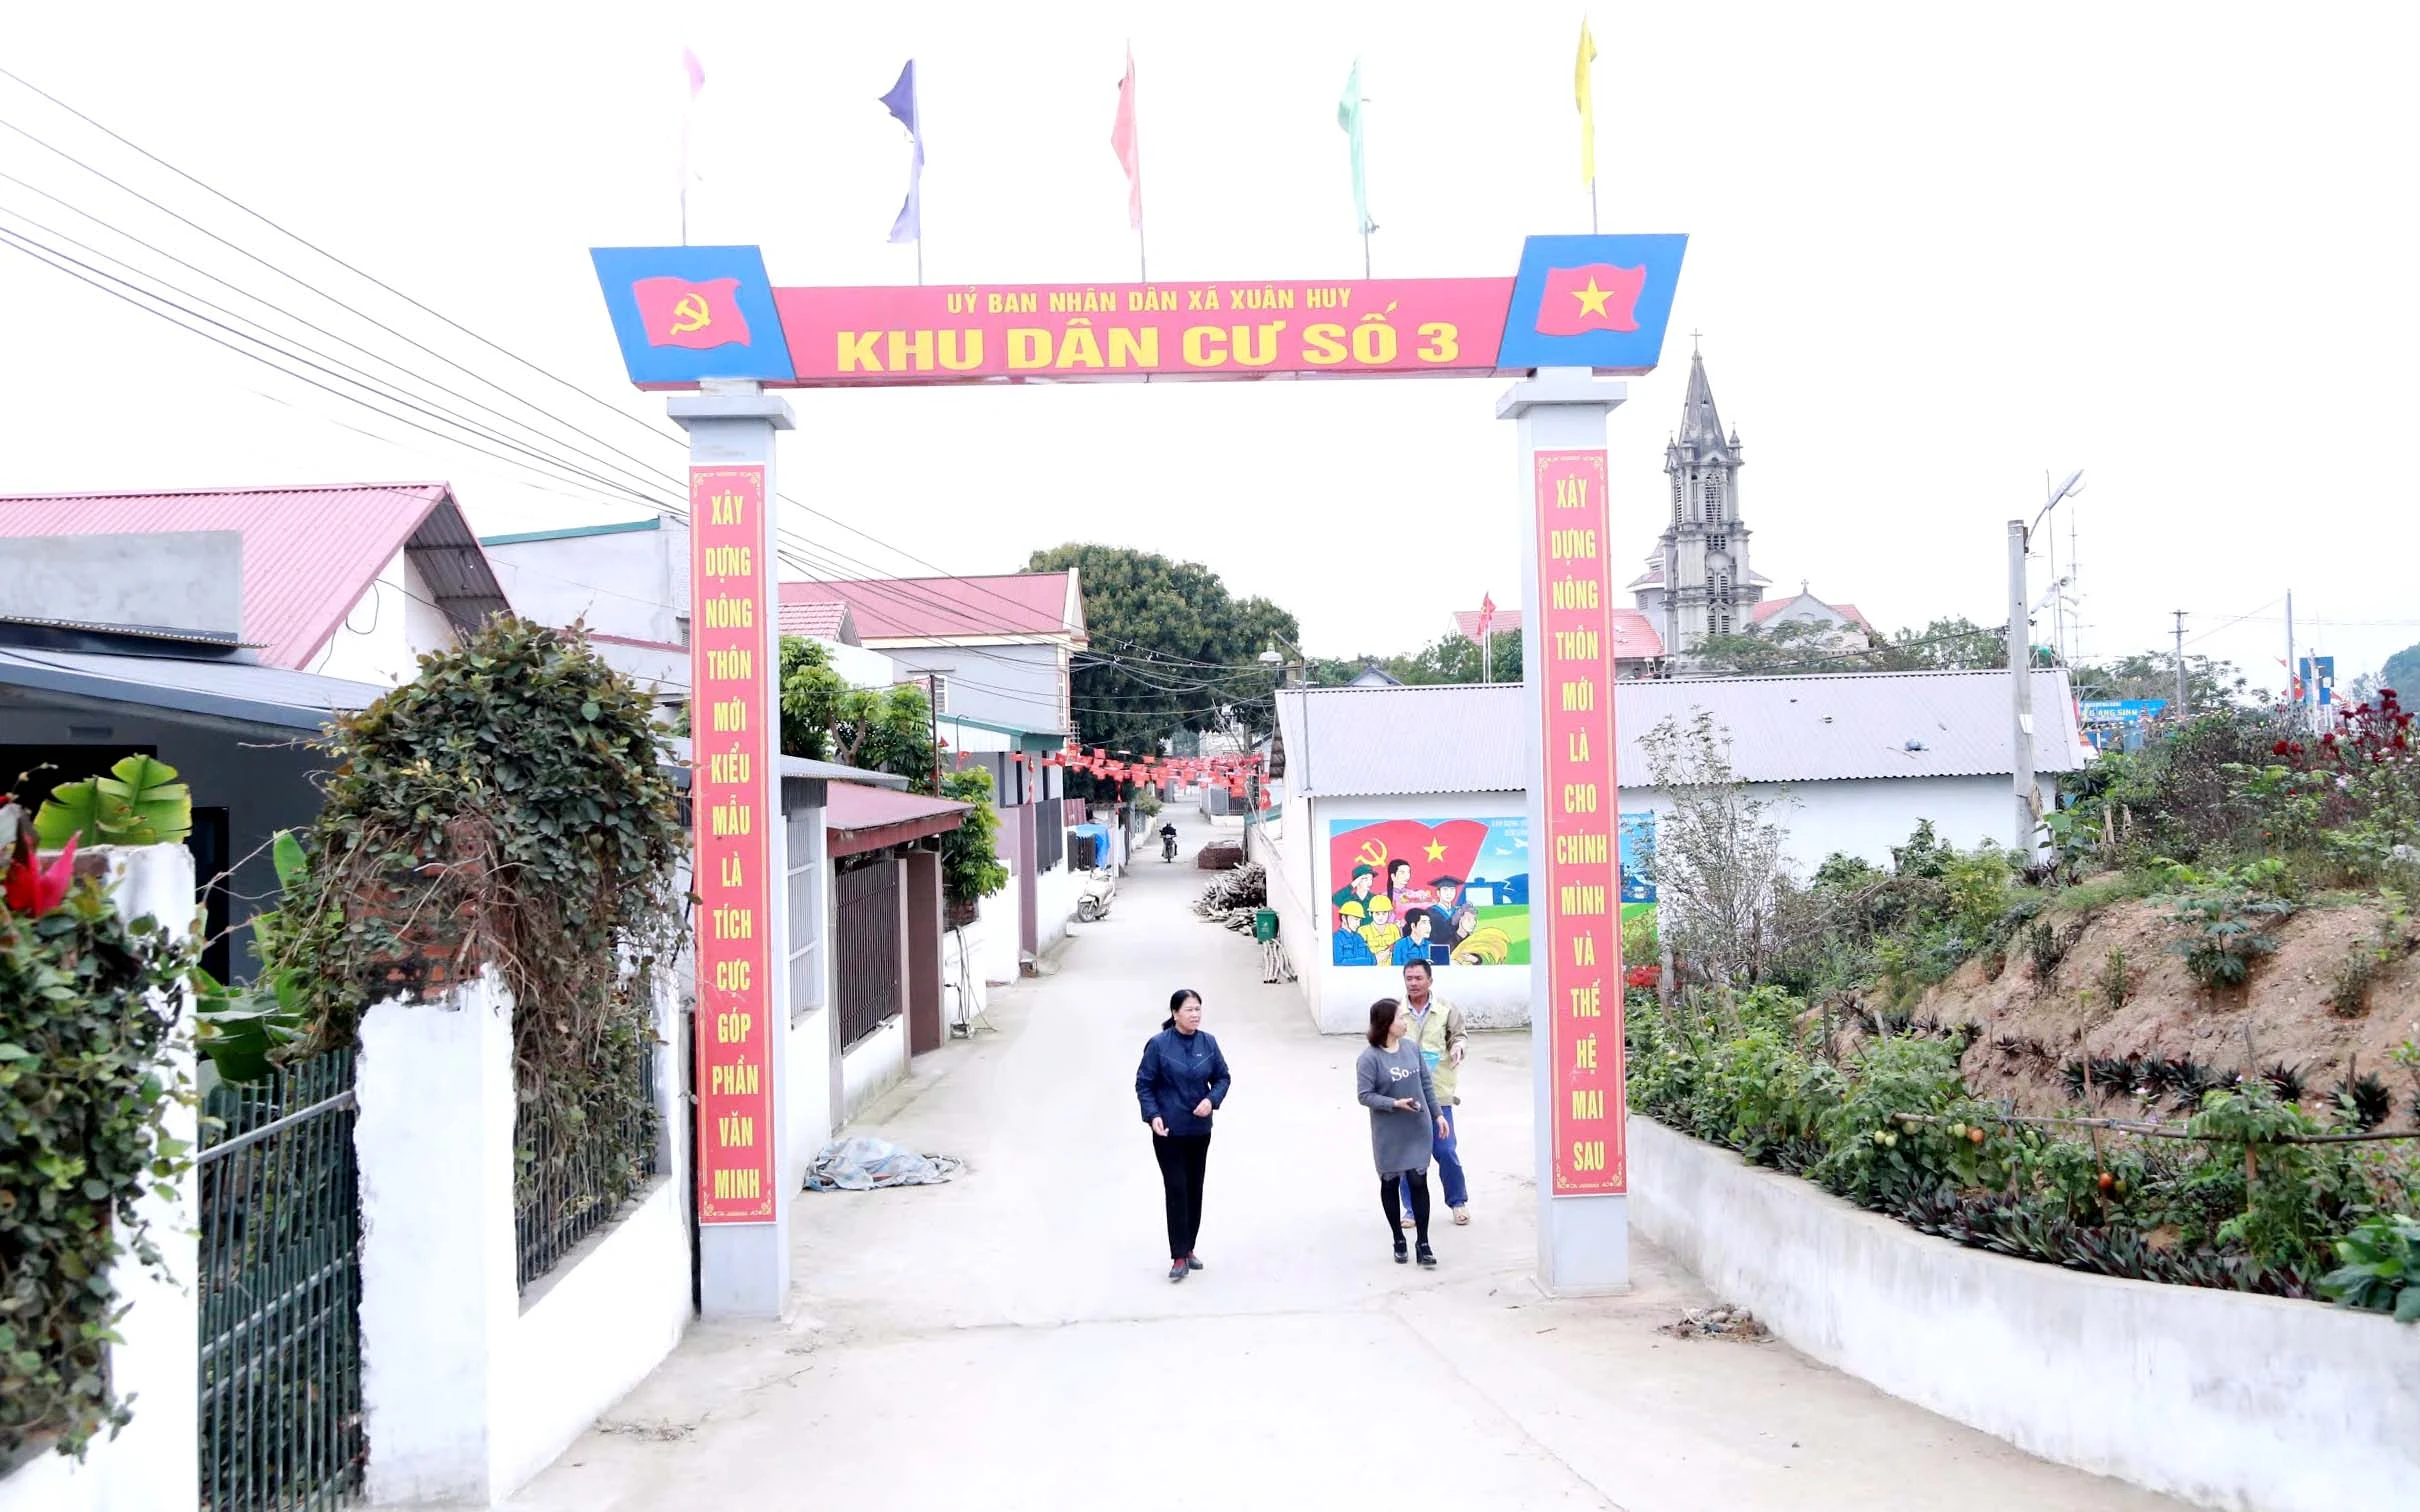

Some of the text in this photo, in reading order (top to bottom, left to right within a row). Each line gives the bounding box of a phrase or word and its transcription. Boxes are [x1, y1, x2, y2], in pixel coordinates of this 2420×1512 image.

[947, 284, 1352, 313] UỶ BAN NHÂN DÂN XÃ XUÂN HUY
[836, 301, 1460, 373] KHU DÂN CƯ SỐ 3
[711, 489, 743, 525] XÂY
[1556, 473, 1588, 508] XÂY
[705, 545, 751, 583] DỰNG
[1551, 528, 1596, 566] DỰNG
[705, 592, 752, 628] NÔNG
[1553, 575, 1600, 610] NÔNG
[1555, 624, 1599, 660] THÔN
[707, 644, 752, 680] THÔN
[1562, 676, 1594, 711] MỚI
[713, 696, 747, 732] MỚI
[1569, 727, 1590, 762] LÀ
[711, 742, 751, 784] KIỂU
[712, 794, 751, 836] MẪU
[1564, 783, 1598, 813] CHO
[1556, 829, 1608, 865] CHÍNH
[721, 851, 743, 888] LÀ
[1561, 880, 1606, 915] MÌNH
[713, 904, 752, 940] TÍCH
[1573, 930, 1596, 966] VÀ
[716, 959, 751, 997] CỰC
[1570, 979, 1601, 1017] THẾ
[717, 1007, 751, 1044] GÓP
[1576, 1033, 1597, 1074] HỆ
[712, 1055, 759, 1095] PHẦN
[1572, 1090, 1604, 1120] MAI
[719, 1111, 753, 1147] VĂN
[1573, 1141, 1605, 1171] SAU
[714, 1169, 760, 1199] MINH
